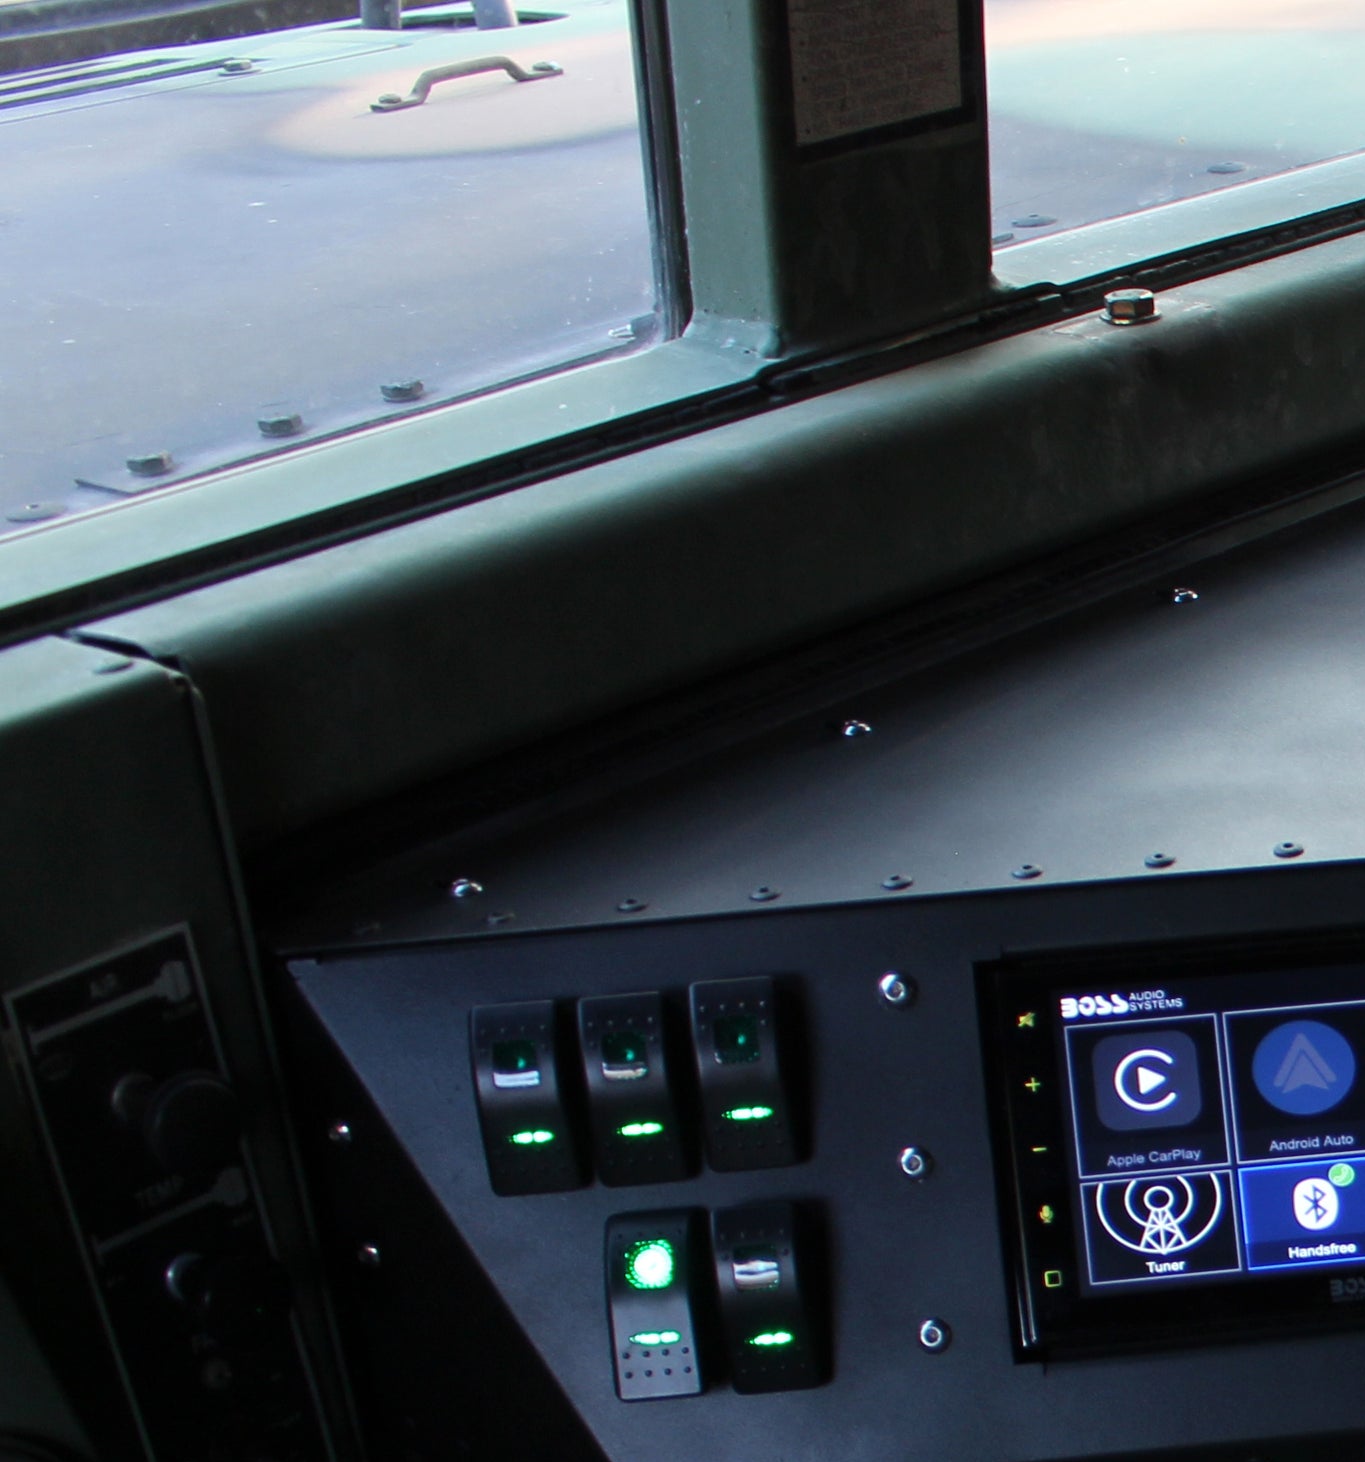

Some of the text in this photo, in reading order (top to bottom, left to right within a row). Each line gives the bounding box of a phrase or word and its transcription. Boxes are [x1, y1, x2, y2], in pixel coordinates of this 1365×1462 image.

[1128, 989, 1165, 1001] AUDIO
[1060, 993, 1129, 1019] BOSS
[1128, 998, 1184, 1012] SYSTEMS
[1269, 1133, 1355, 1152] Android Auto
[1106, 1148, 1201, 1168] Apple CarPlay
[1287, 1241, 1357, 1260] Handsfree
[1145, 1258, 1186, 1274] Tuner
